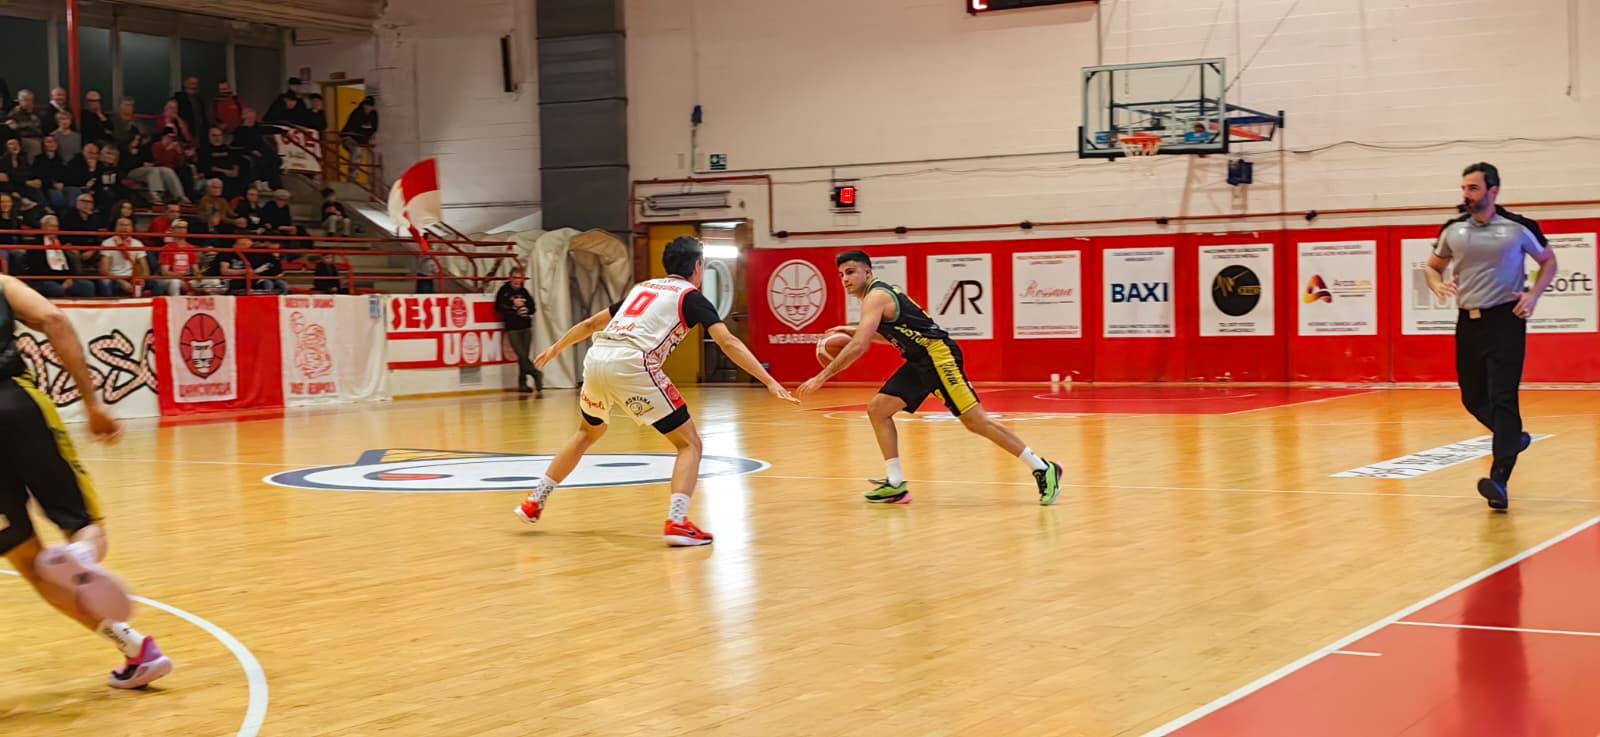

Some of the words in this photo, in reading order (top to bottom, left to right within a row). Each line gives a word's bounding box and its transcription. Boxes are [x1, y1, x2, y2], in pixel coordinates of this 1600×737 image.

[623, 291, 657, 317] 0
[1111, 282, 1169, 303] BAXI
[391, 297, 469, 330] SESTO
